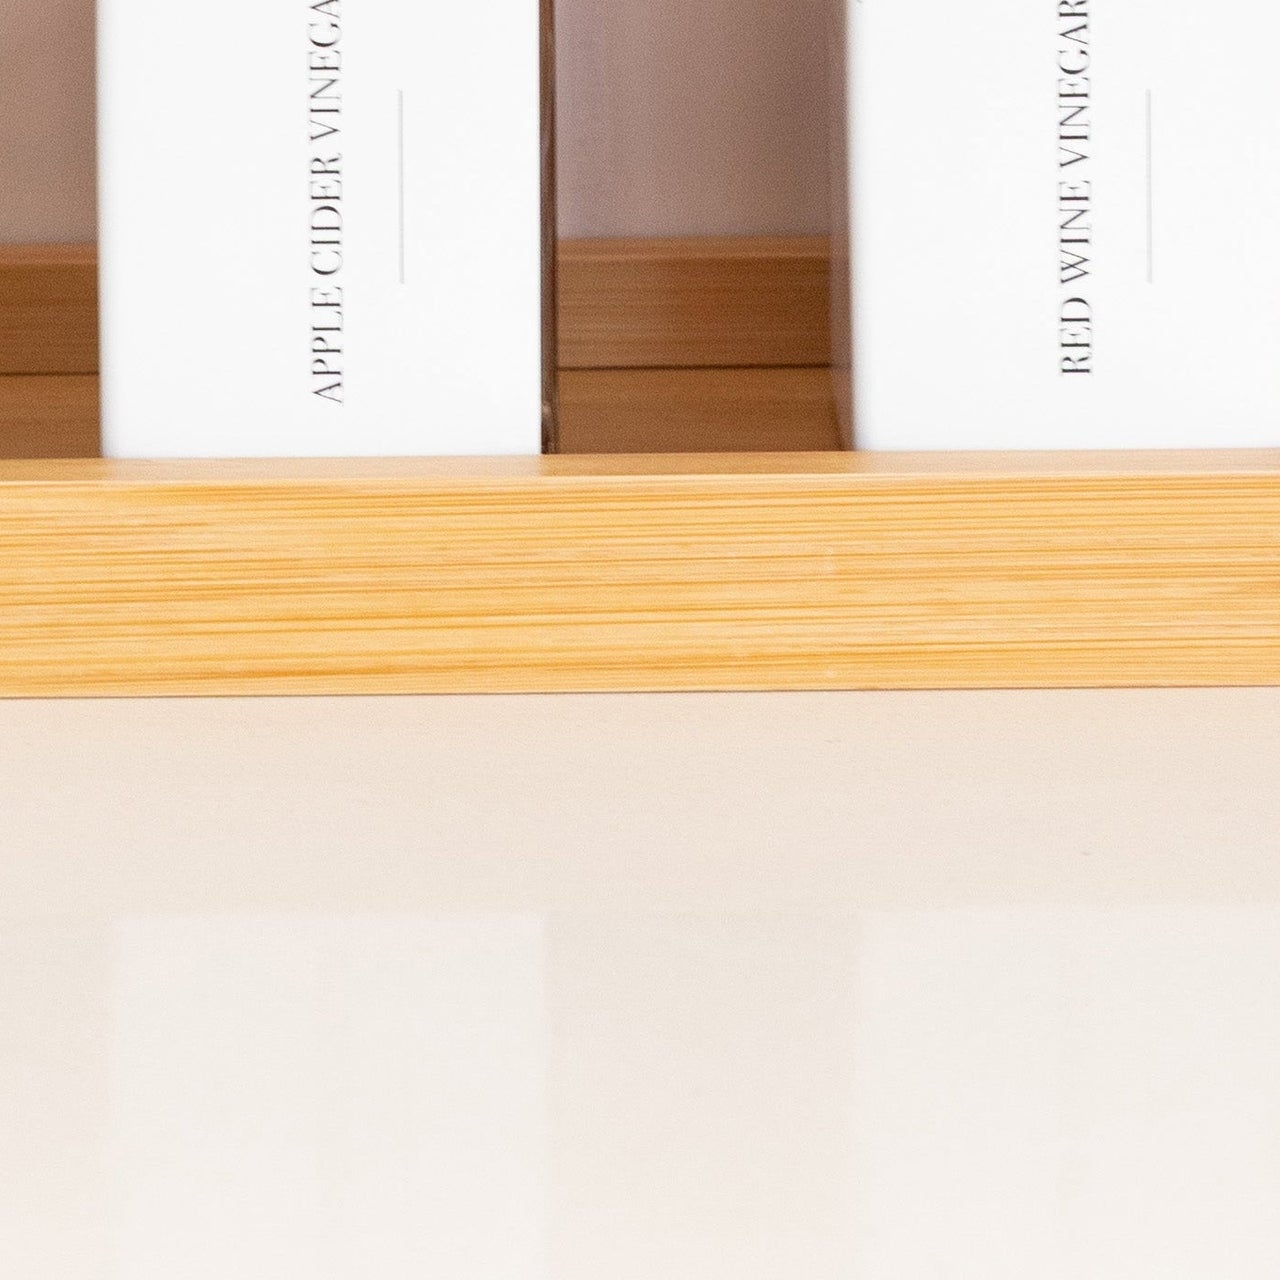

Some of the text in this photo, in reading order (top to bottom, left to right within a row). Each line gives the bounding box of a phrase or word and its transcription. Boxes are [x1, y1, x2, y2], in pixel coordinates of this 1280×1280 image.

[310, 153, 342, 277] CIDER
[1058, 180, 1091, 285] WINE
[311, 286, 343, 406] APPLE
[1060, 296, 1092, 376] RED
